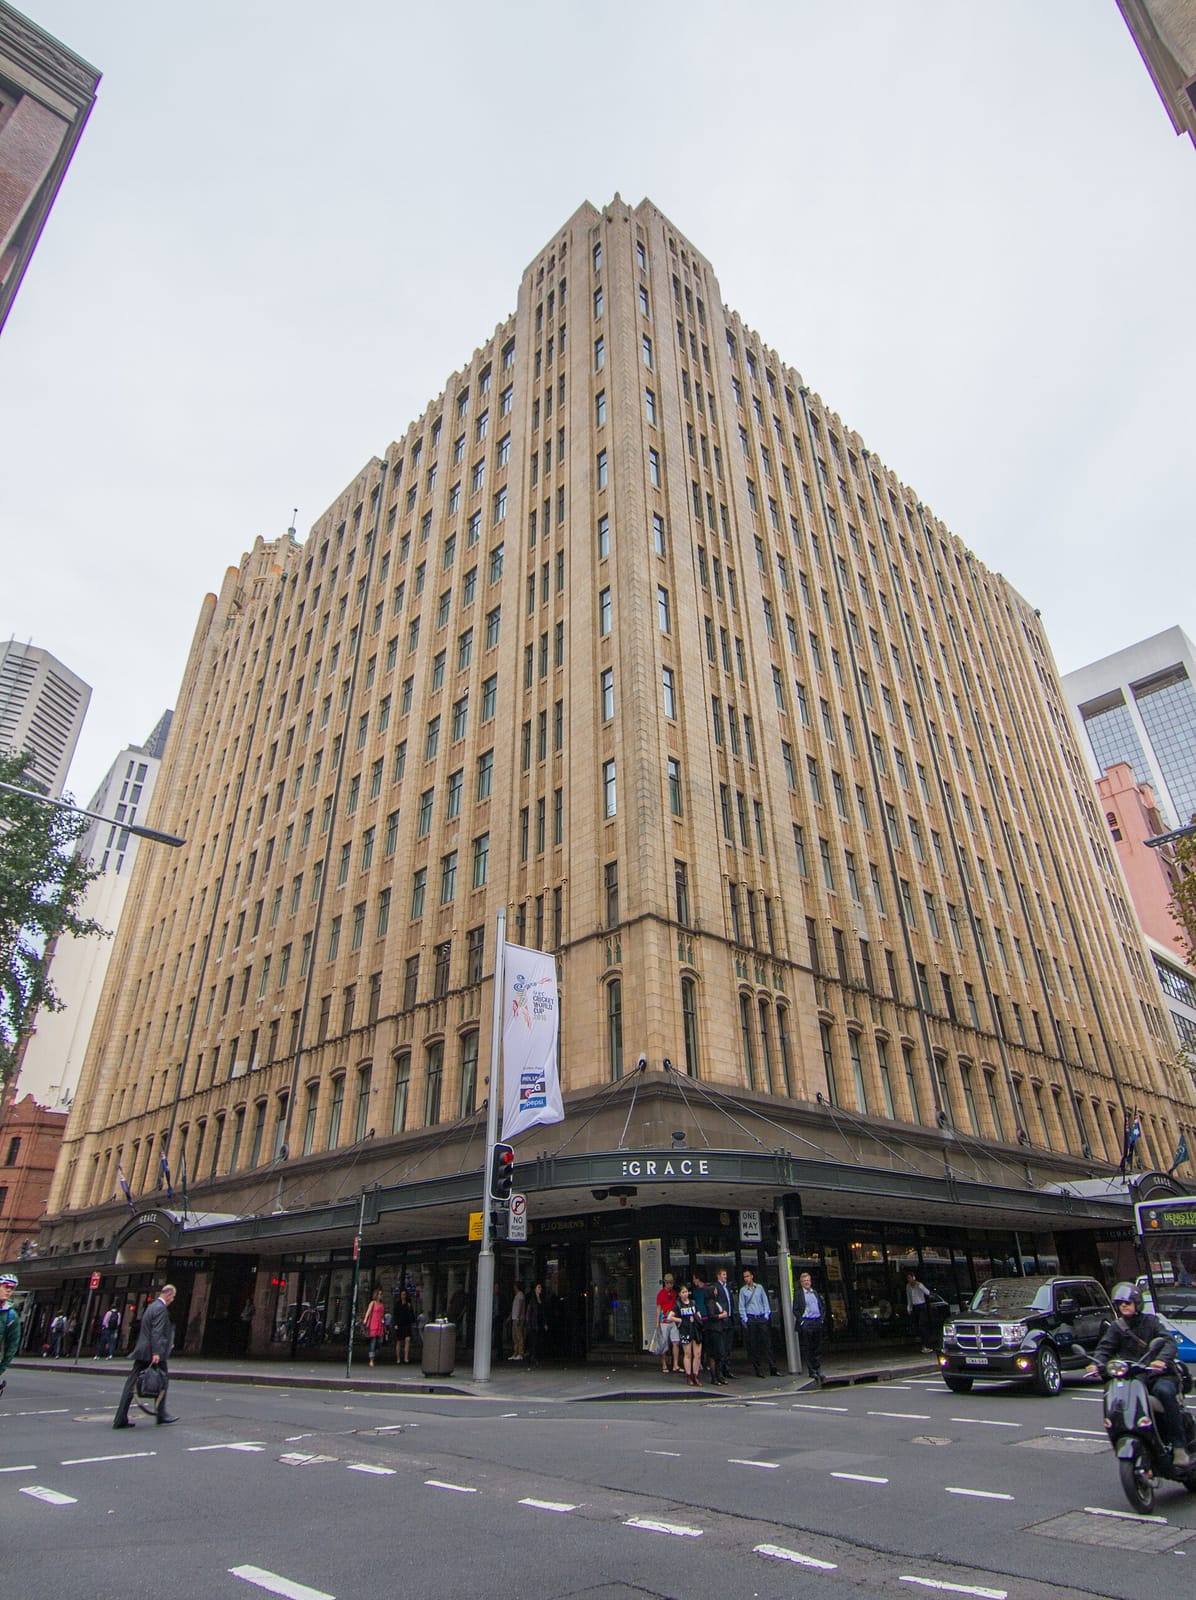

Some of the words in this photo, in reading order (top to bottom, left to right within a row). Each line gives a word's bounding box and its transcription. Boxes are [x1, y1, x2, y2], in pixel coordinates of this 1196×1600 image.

[629, 1160, 709, 1176] GRACE
[742, 1211, 756, 1219] ONE
[513, 1216, 523, 1224] NO
[742, 1222, 759, 1230] WAY
